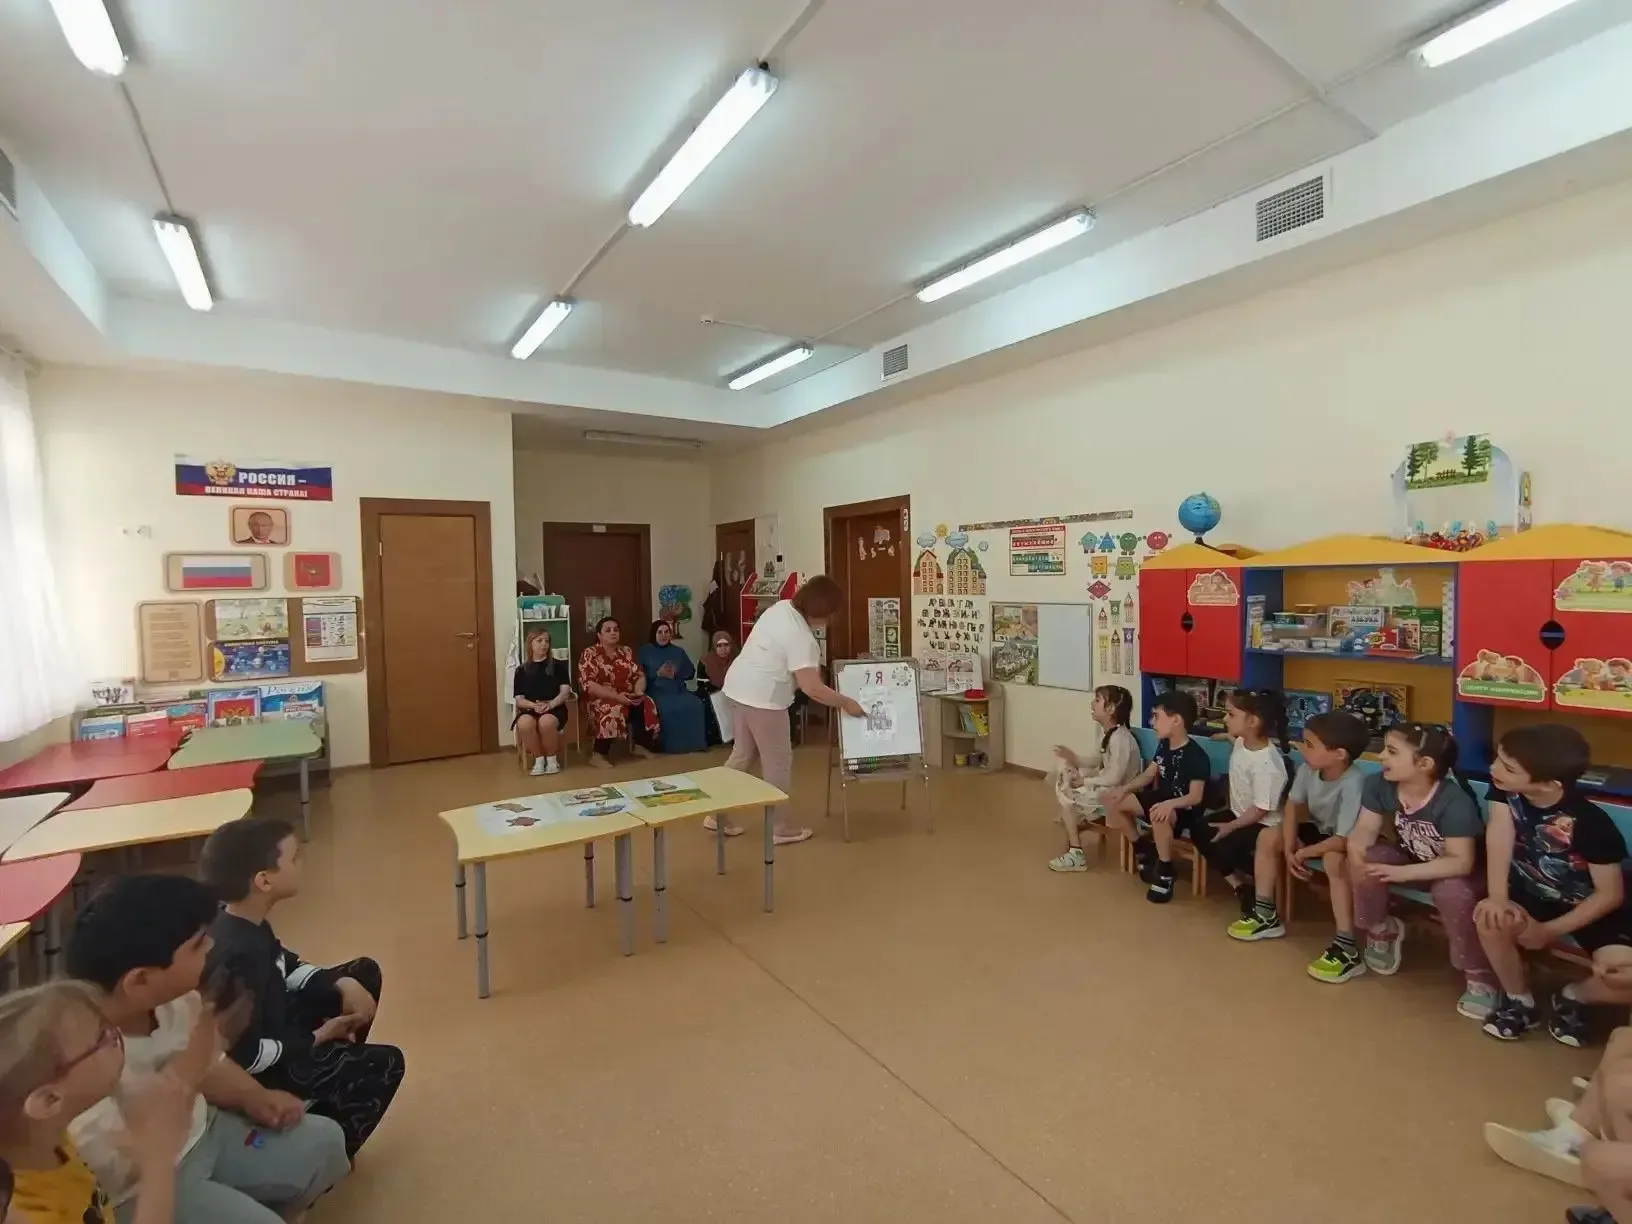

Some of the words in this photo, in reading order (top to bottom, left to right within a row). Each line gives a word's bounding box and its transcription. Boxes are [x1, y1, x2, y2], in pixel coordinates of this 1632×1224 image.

[238, 471, 296, 486] РОССИЯ
[246, 486, 272, 496] НАША
[273, 489, 308, 498] СТРАНА!
[875, 671, 883, 685] Я
